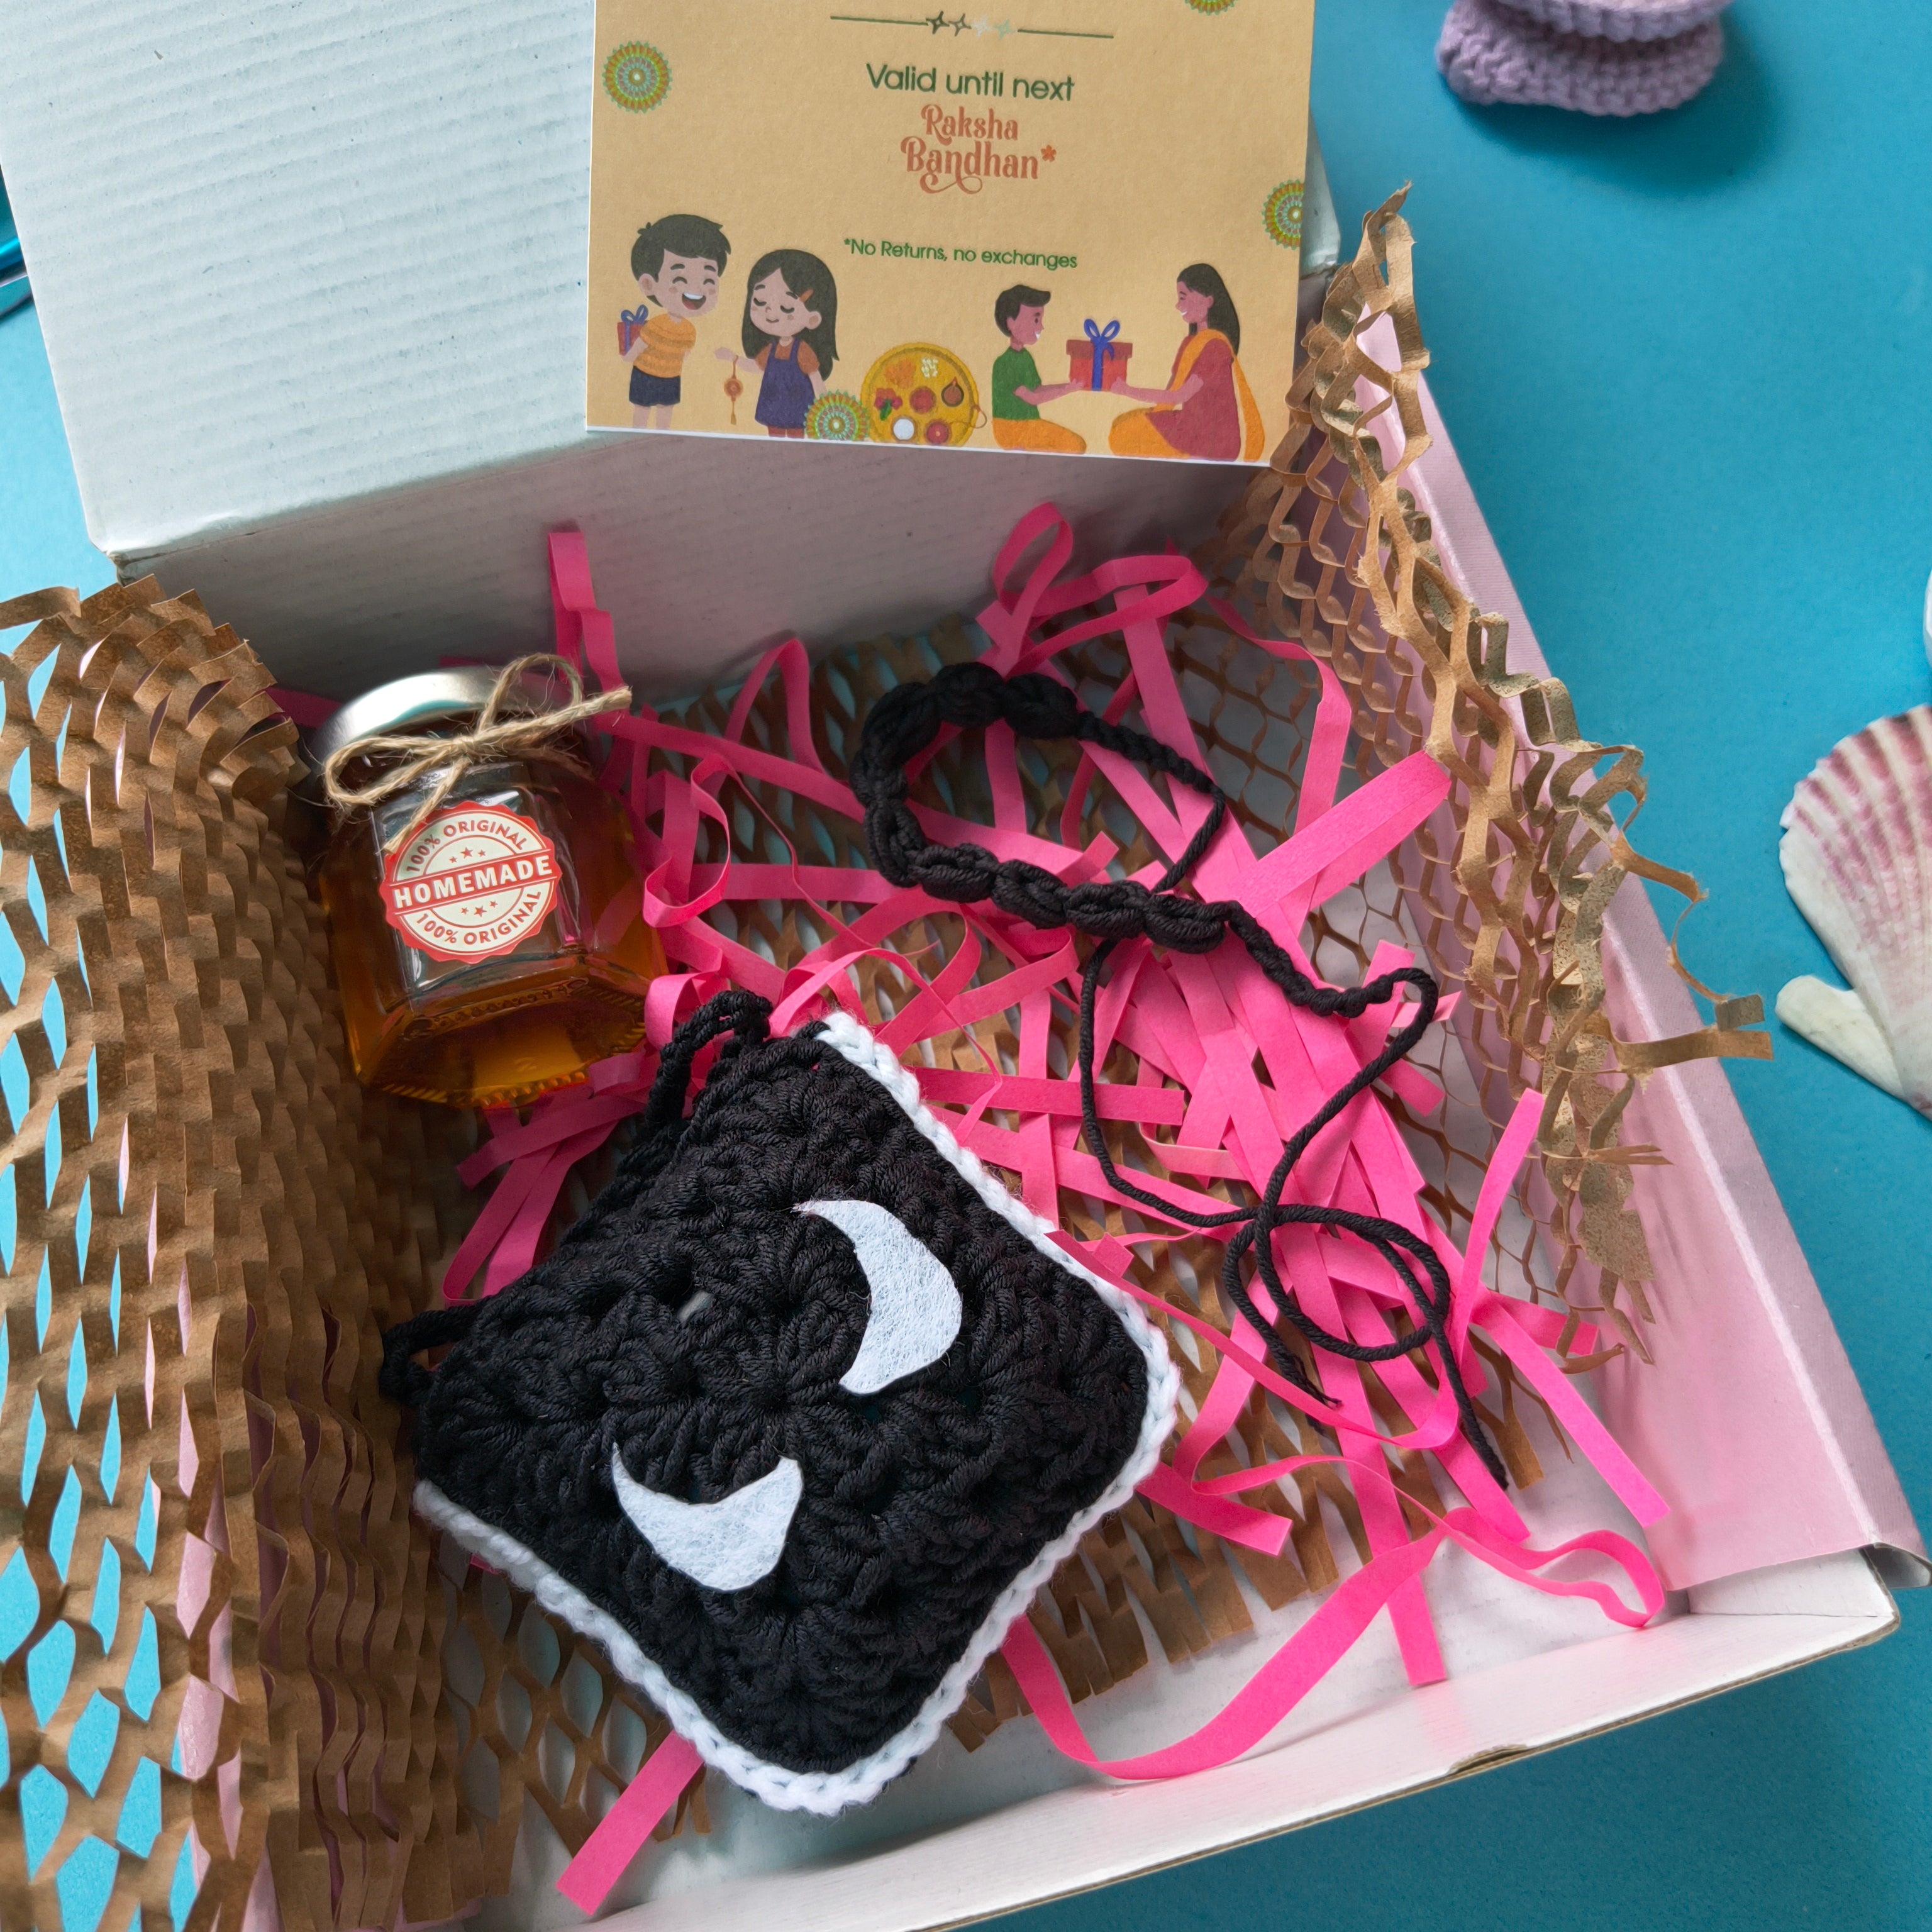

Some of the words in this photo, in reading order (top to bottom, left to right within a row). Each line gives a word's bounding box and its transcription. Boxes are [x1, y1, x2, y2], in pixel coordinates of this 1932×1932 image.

[866, 64, 936, 92] Valid
[946, 71, 1003, 96] until
[1013, 75, 1075, 101] next
[921, 104, 1018, 145] Raksha
[881, 241, 947, 262] Returns,
[953, 248, 976, 262] no
[981, 249, 1078, 271] exchanges
[406, 834, 440, 872] 100%
[443, 819, 527, 850] ORIGINAL
[392, 855, 552, 909] HOMEMADE
[416, 913, 458, 944] 100%
[463, 890, 541, 945] ORIGINAL
